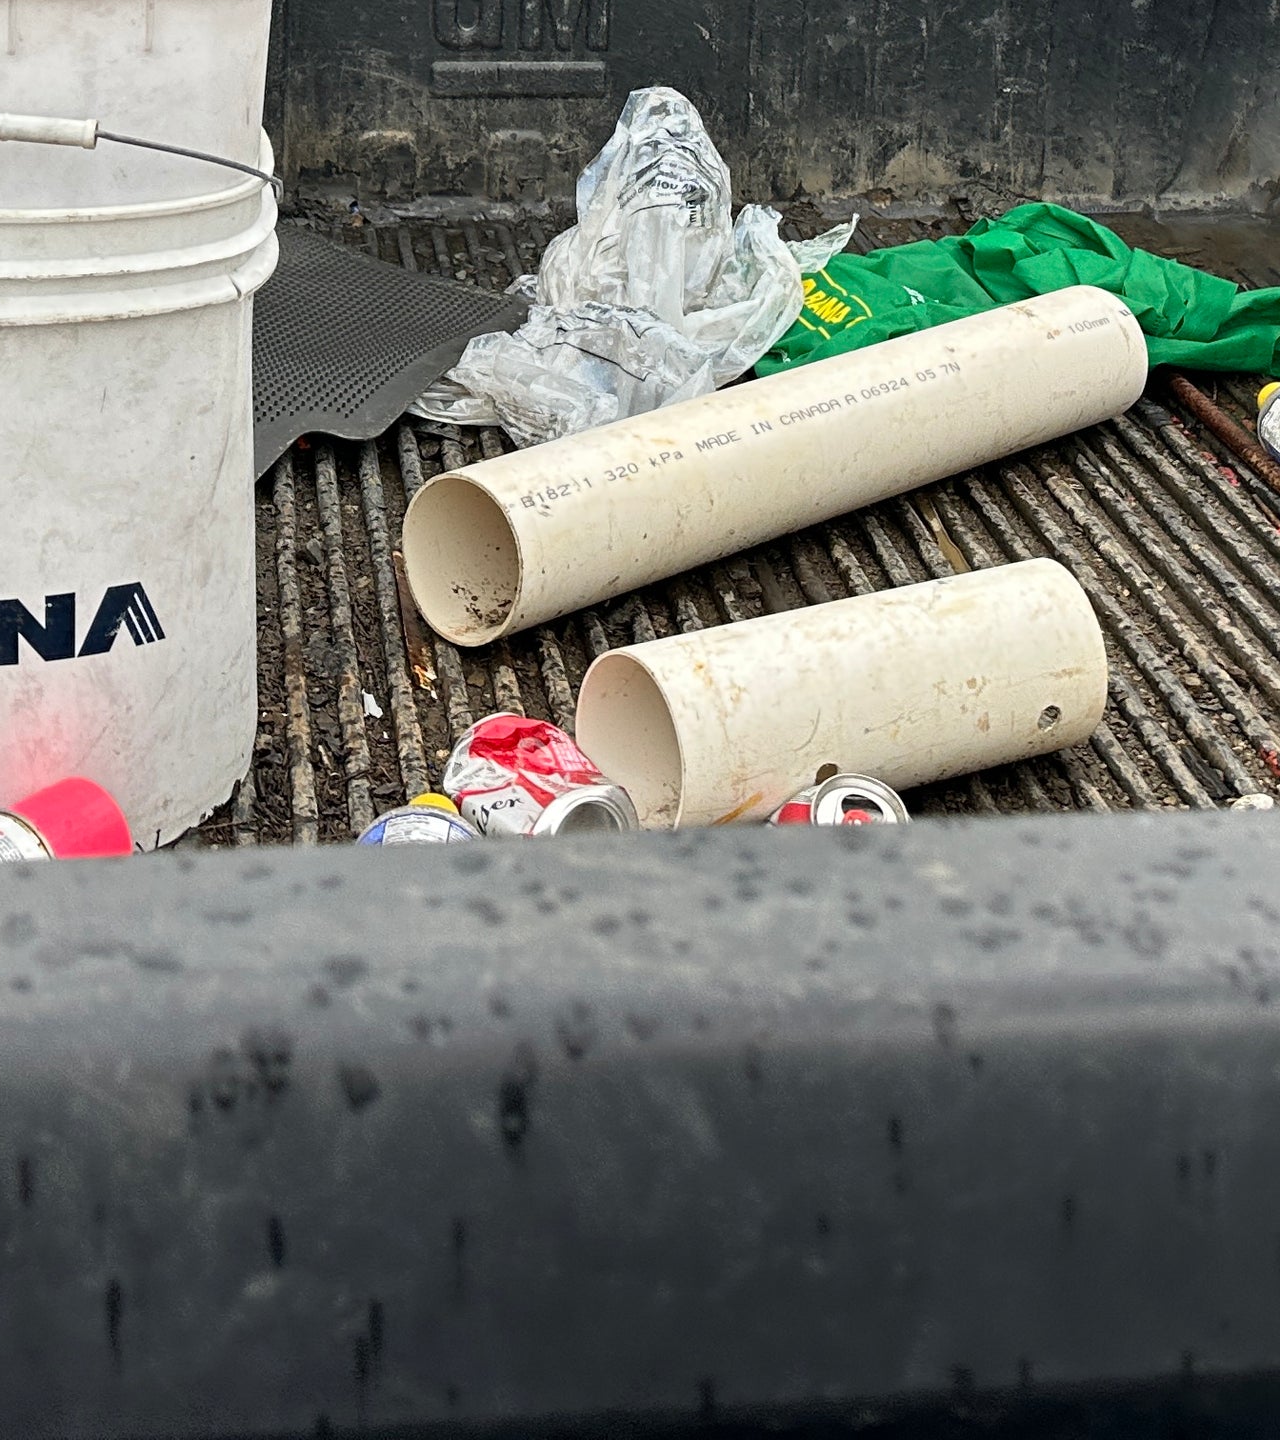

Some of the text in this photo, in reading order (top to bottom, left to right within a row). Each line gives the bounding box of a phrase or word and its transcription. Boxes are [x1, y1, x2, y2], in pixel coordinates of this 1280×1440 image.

[603, 462, 640, 482] 320
[648, 450, 685, 468] kPa
[695, 429, 742, 453] MADE
[750, 419, 773, 435] IN
[779, 398, 842, 426] CANADA
[860, 377, 910, 400] 06924
